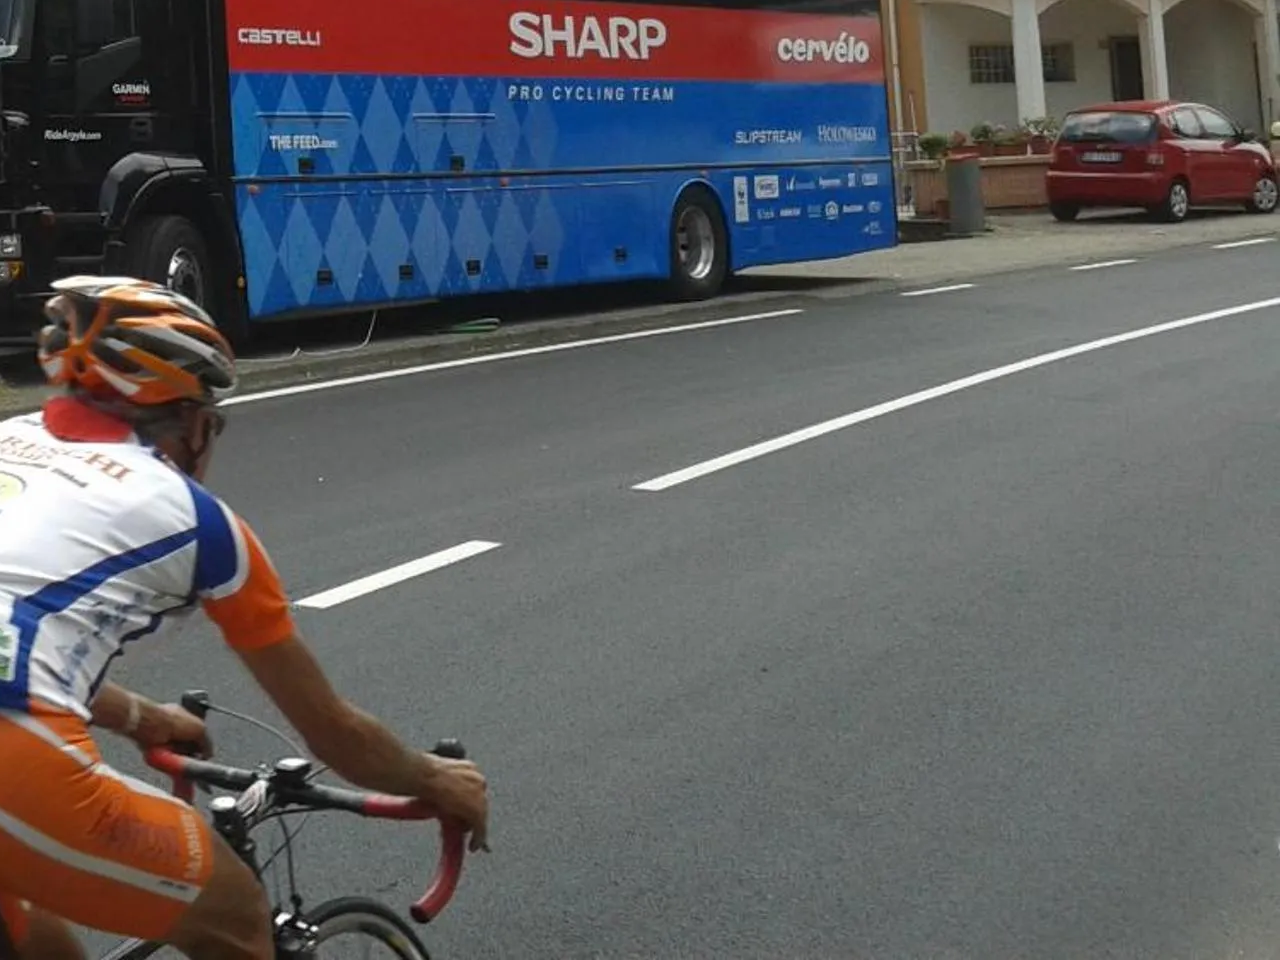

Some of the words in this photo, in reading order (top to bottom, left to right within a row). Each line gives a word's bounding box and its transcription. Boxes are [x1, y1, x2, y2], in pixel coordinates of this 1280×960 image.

[509, 11, 667, 60] SHARP
[777, 31, 869, 63] cervélo
[508, 85, 544, 101] PRO
[552, 86, 624, 101] CYCLING
[633, 87, 674, 101] TEAM
[735, 130, 802, 144] SLIPSTREAM
